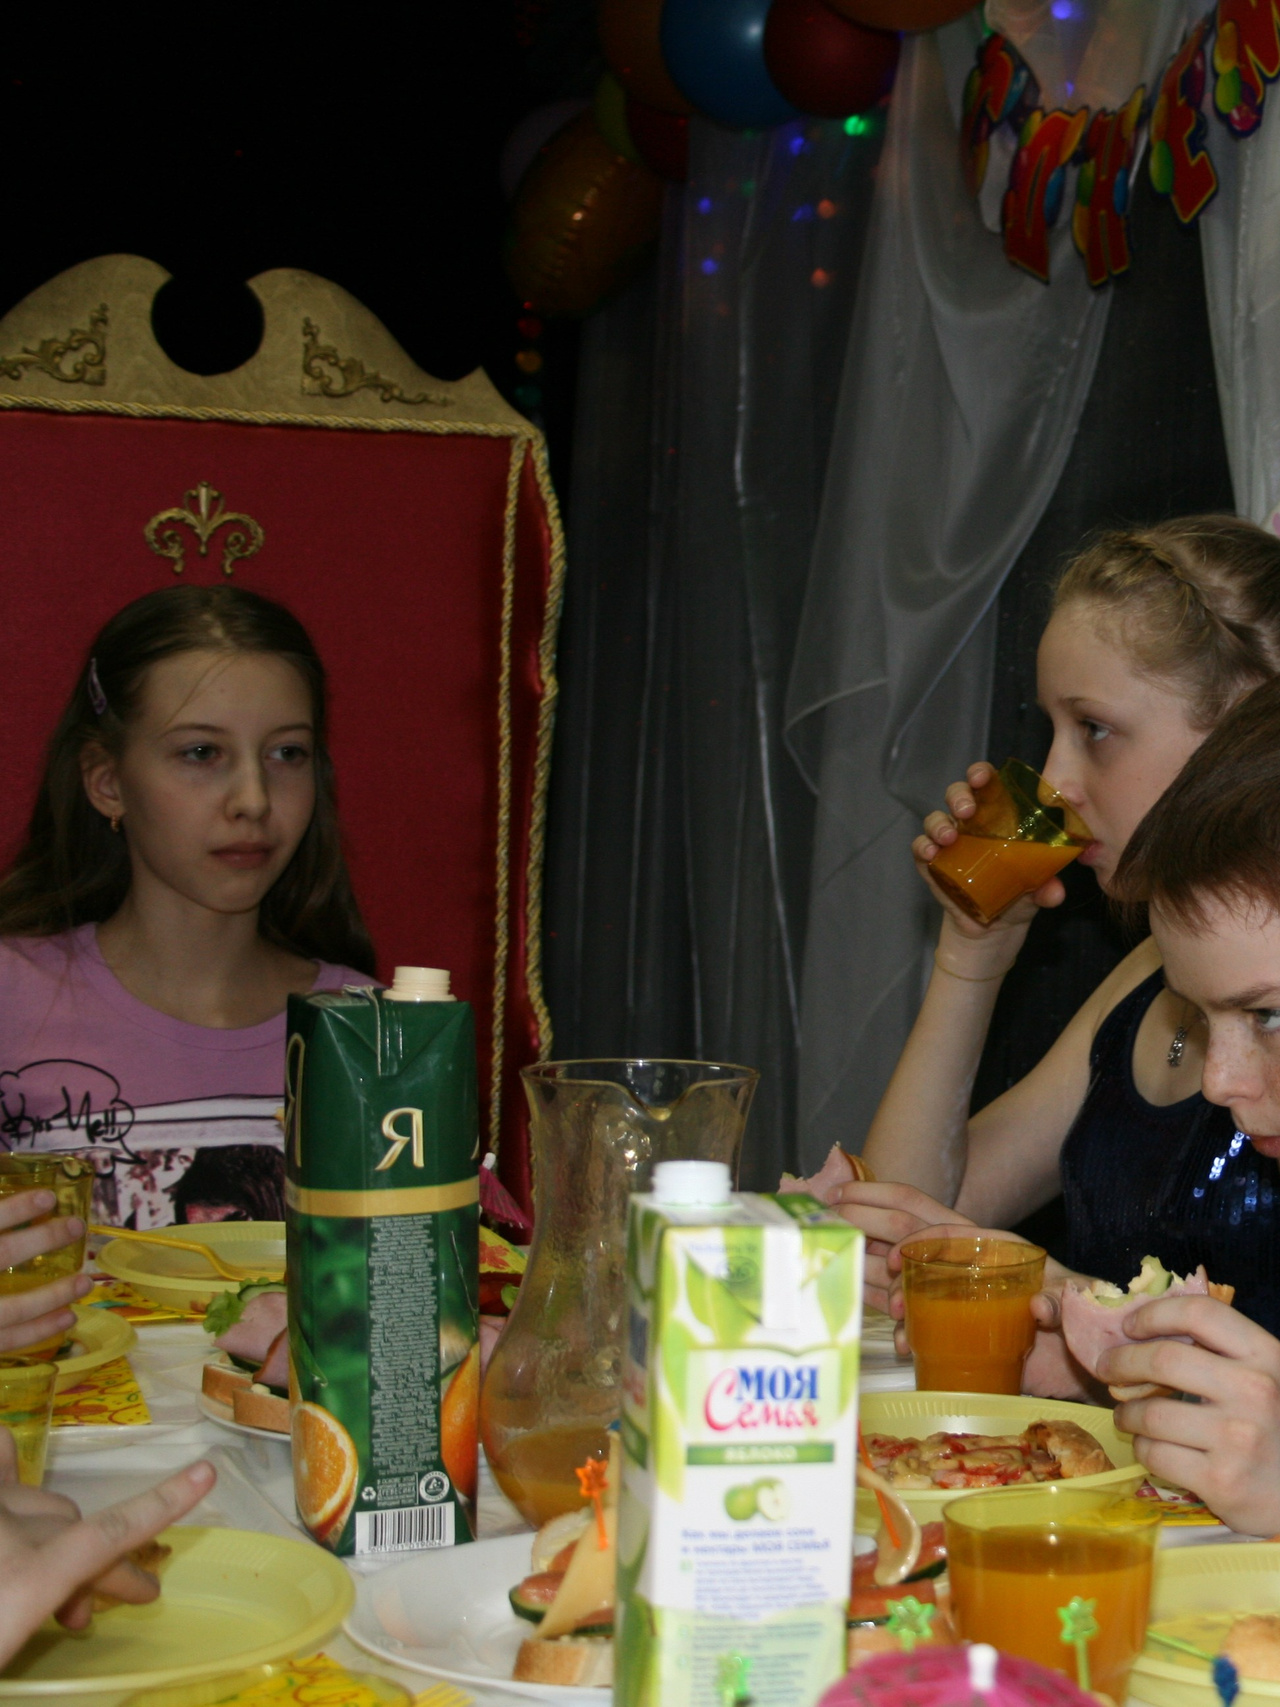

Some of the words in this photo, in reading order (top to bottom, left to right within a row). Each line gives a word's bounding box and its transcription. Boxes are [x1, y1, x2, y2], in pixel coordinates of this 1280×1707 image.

[375, 1107, 424, 1170] Я
[704, 1368, 818, 1431] Семья
[738, 1366, 818, 1400] МОЯ
